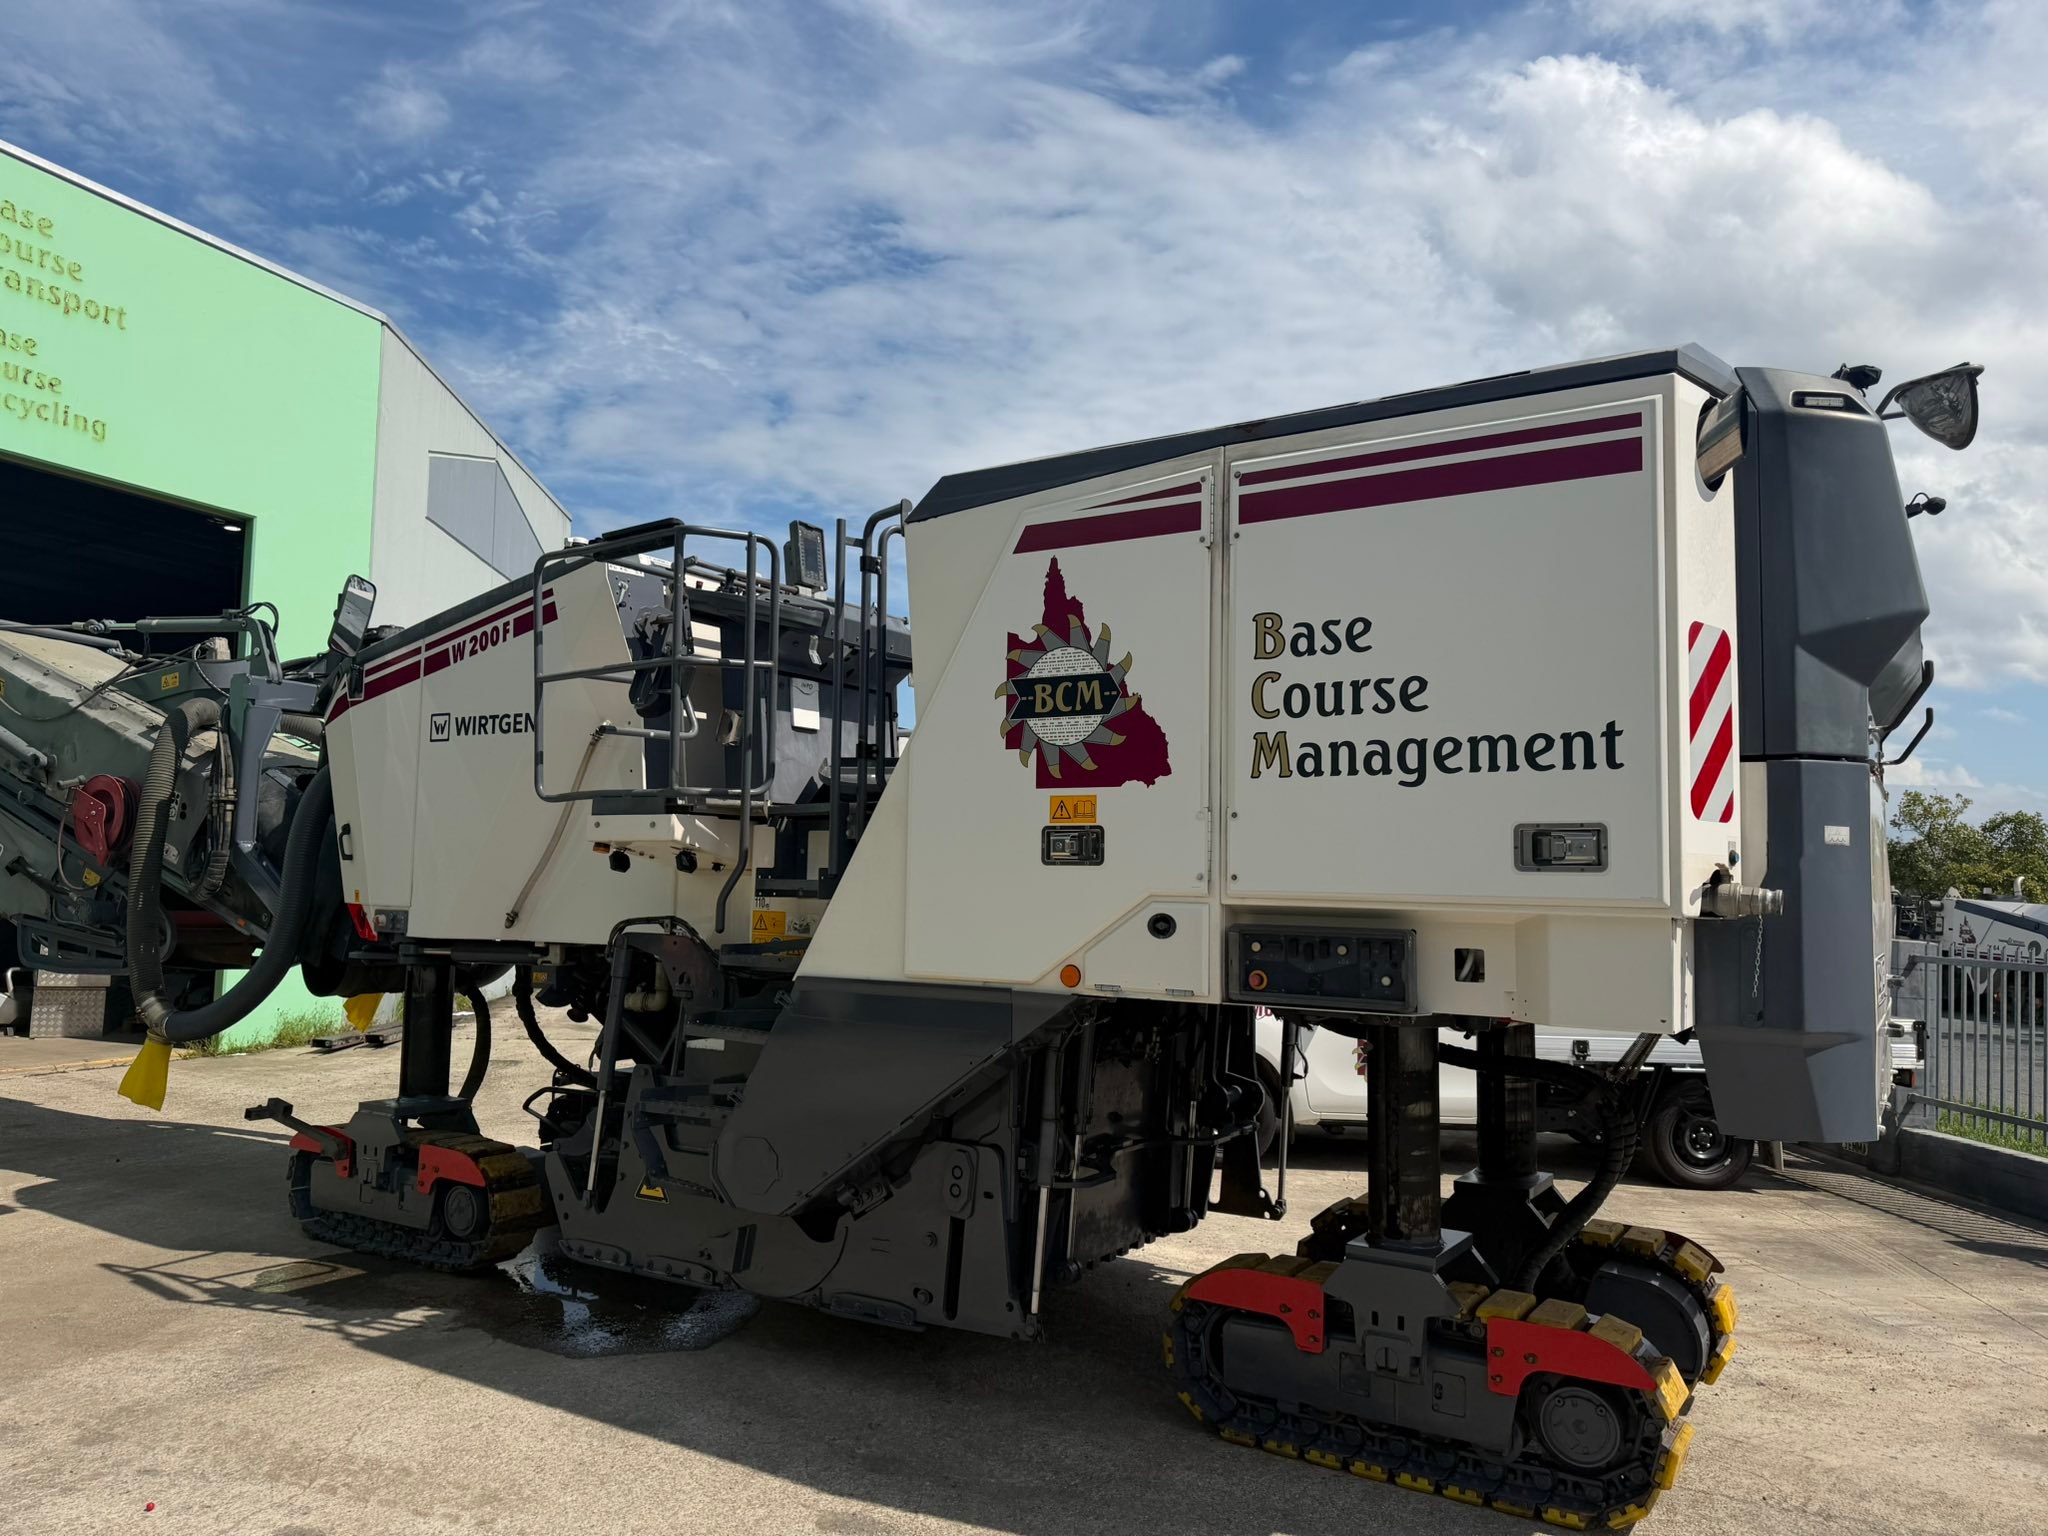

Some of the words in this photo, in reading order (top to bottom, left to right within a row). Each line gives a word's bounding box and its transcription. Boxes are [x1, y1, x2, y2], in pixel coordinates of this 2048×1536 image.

[0, 266, 127, 330] ansport
[0, 361, 62, 394] urse
[0, 393, 107, 442] cycling
[1252, 611, 1373, 660] Base
[1034, 680, 1104, 713] BCM
[1250, 670, 1429, 720] Course
[454, 712, 536, 736] WIRTGEN
[1250, 719, 1625, 788] Management
